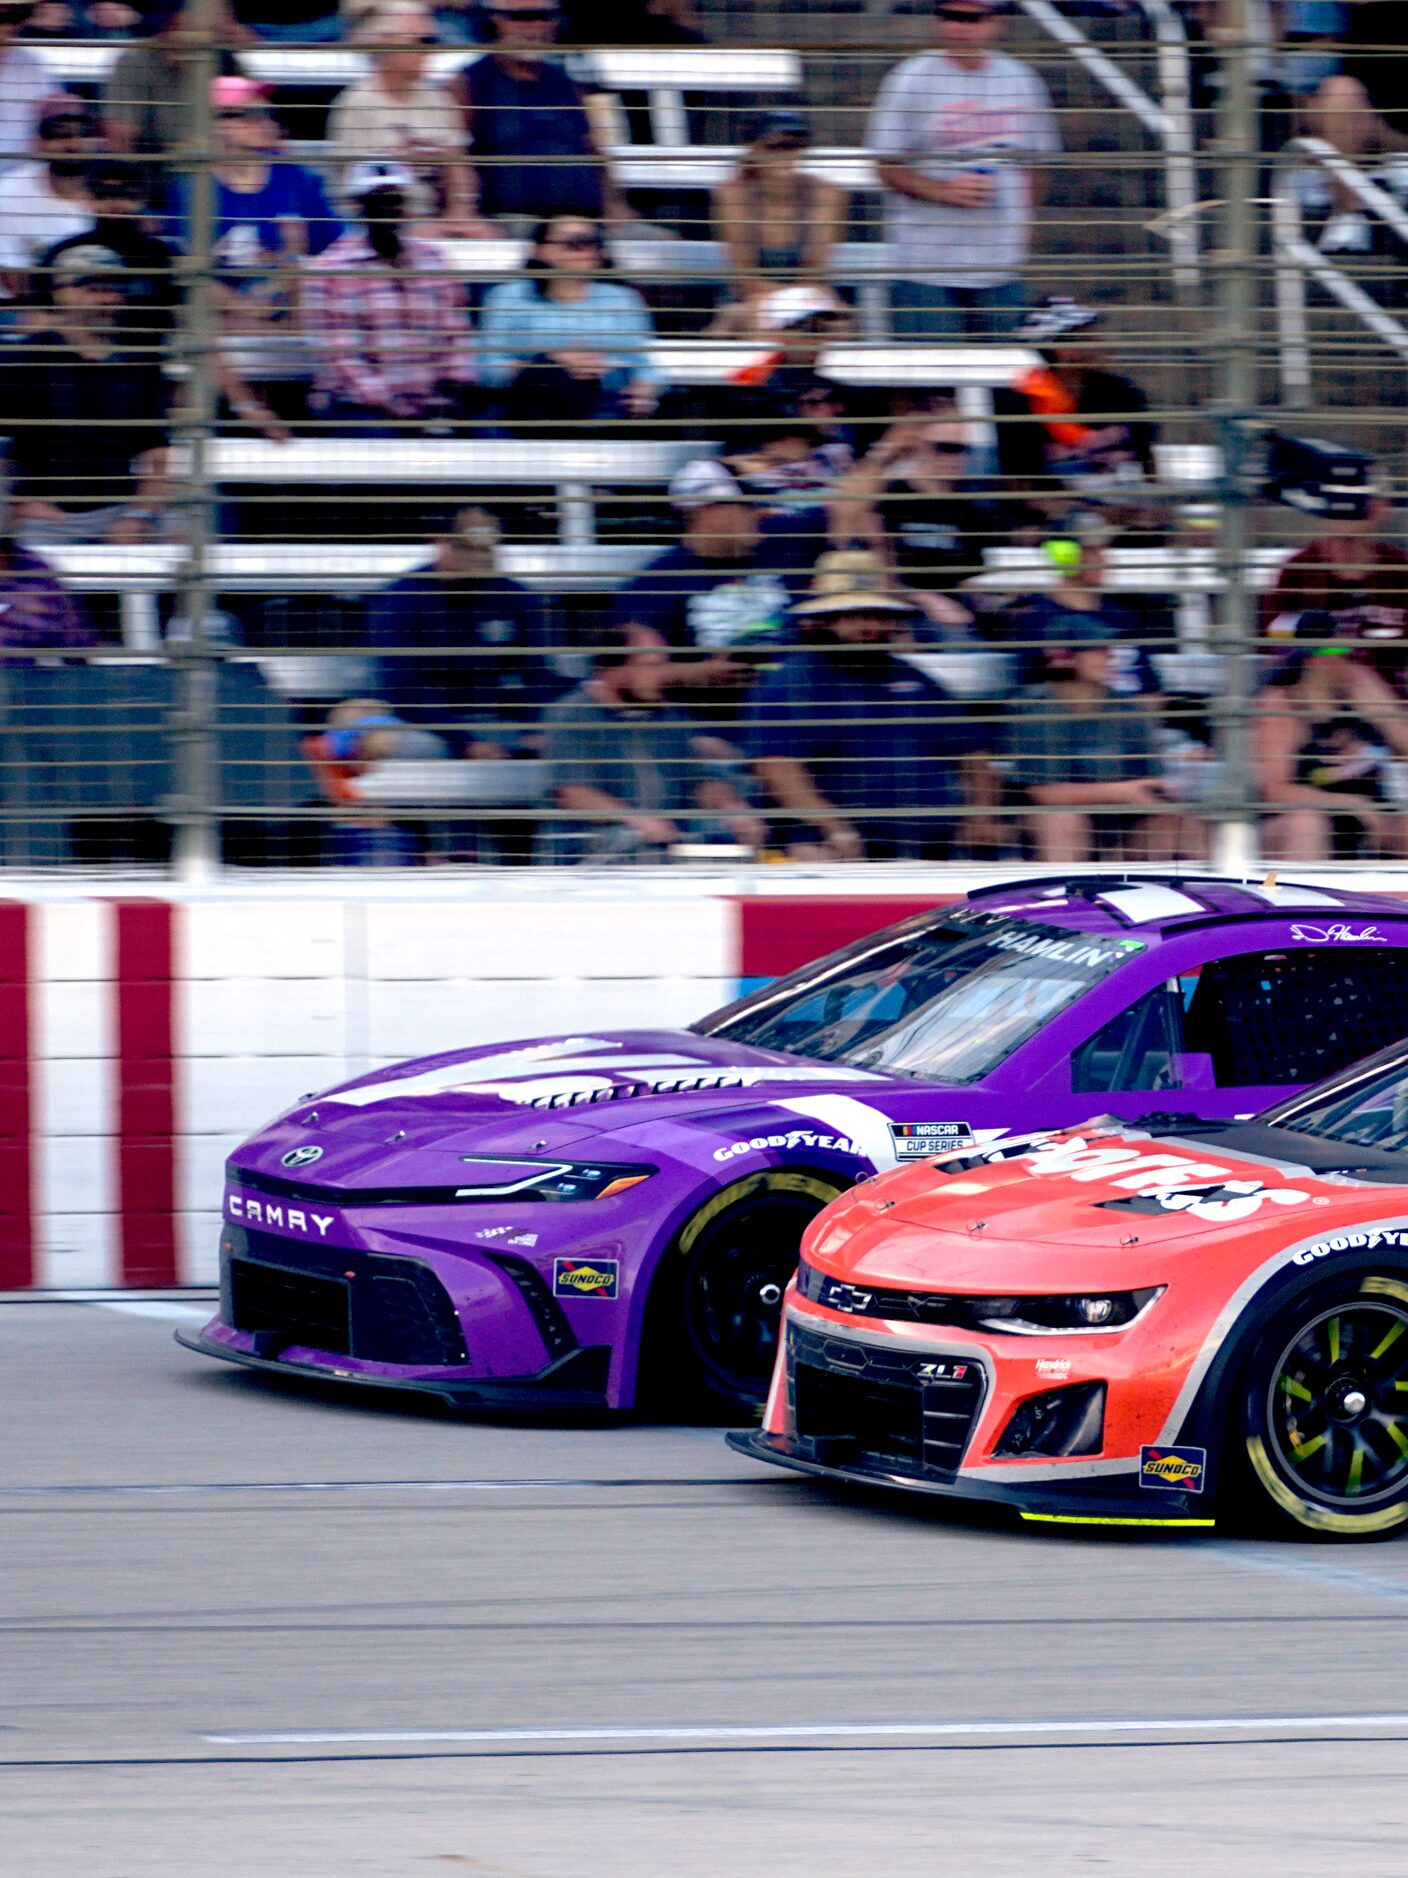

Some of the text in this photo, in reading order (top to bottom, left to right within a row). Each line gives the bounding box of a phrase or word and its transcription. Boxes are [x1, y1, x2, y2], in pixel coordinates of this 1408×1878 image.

[987, 931, 1114, 967] HAMLIN
[916, 1125, 959, 1136] NASCAR
[713, 1131, 868, 1161] GOODYEA
[906, 1140, 964, 1152] CUP SERIES
[229, 1195, 334, 1236] CAMRY
[559, 1273, 614, 1286] SUNOCO
[916, 1362, 968, 1380] ZL1
[1145, 1462, 1200, 1476] SUNOCO
